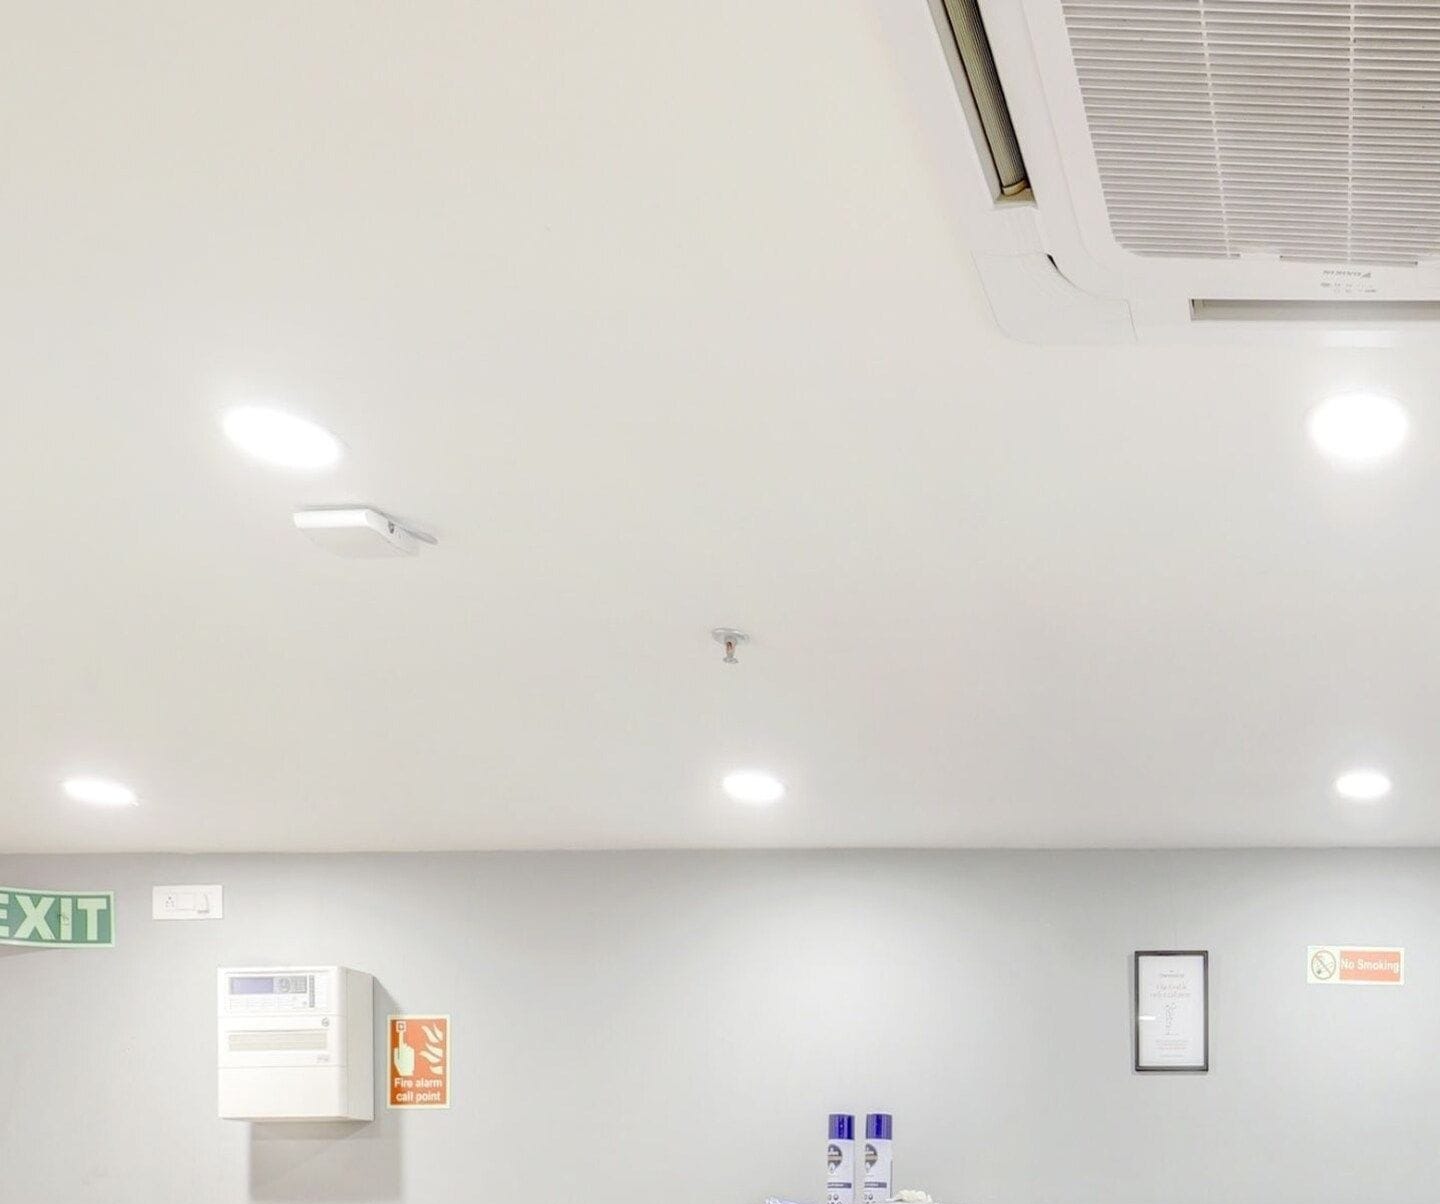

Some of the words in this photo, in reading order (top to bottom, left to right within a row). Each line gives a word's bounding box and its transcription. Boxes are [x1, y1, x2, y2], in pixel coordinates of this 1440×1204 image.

[1340, 958, 1355, 970] No
[1357, 958, 1399, 974] Smoking
[394, 1077, 413, 1089] Fire
[415, 1077, 443, 1089] alarm
[395, 1090, 413, 1102] call
[416, 1090, 441, 1104] point
